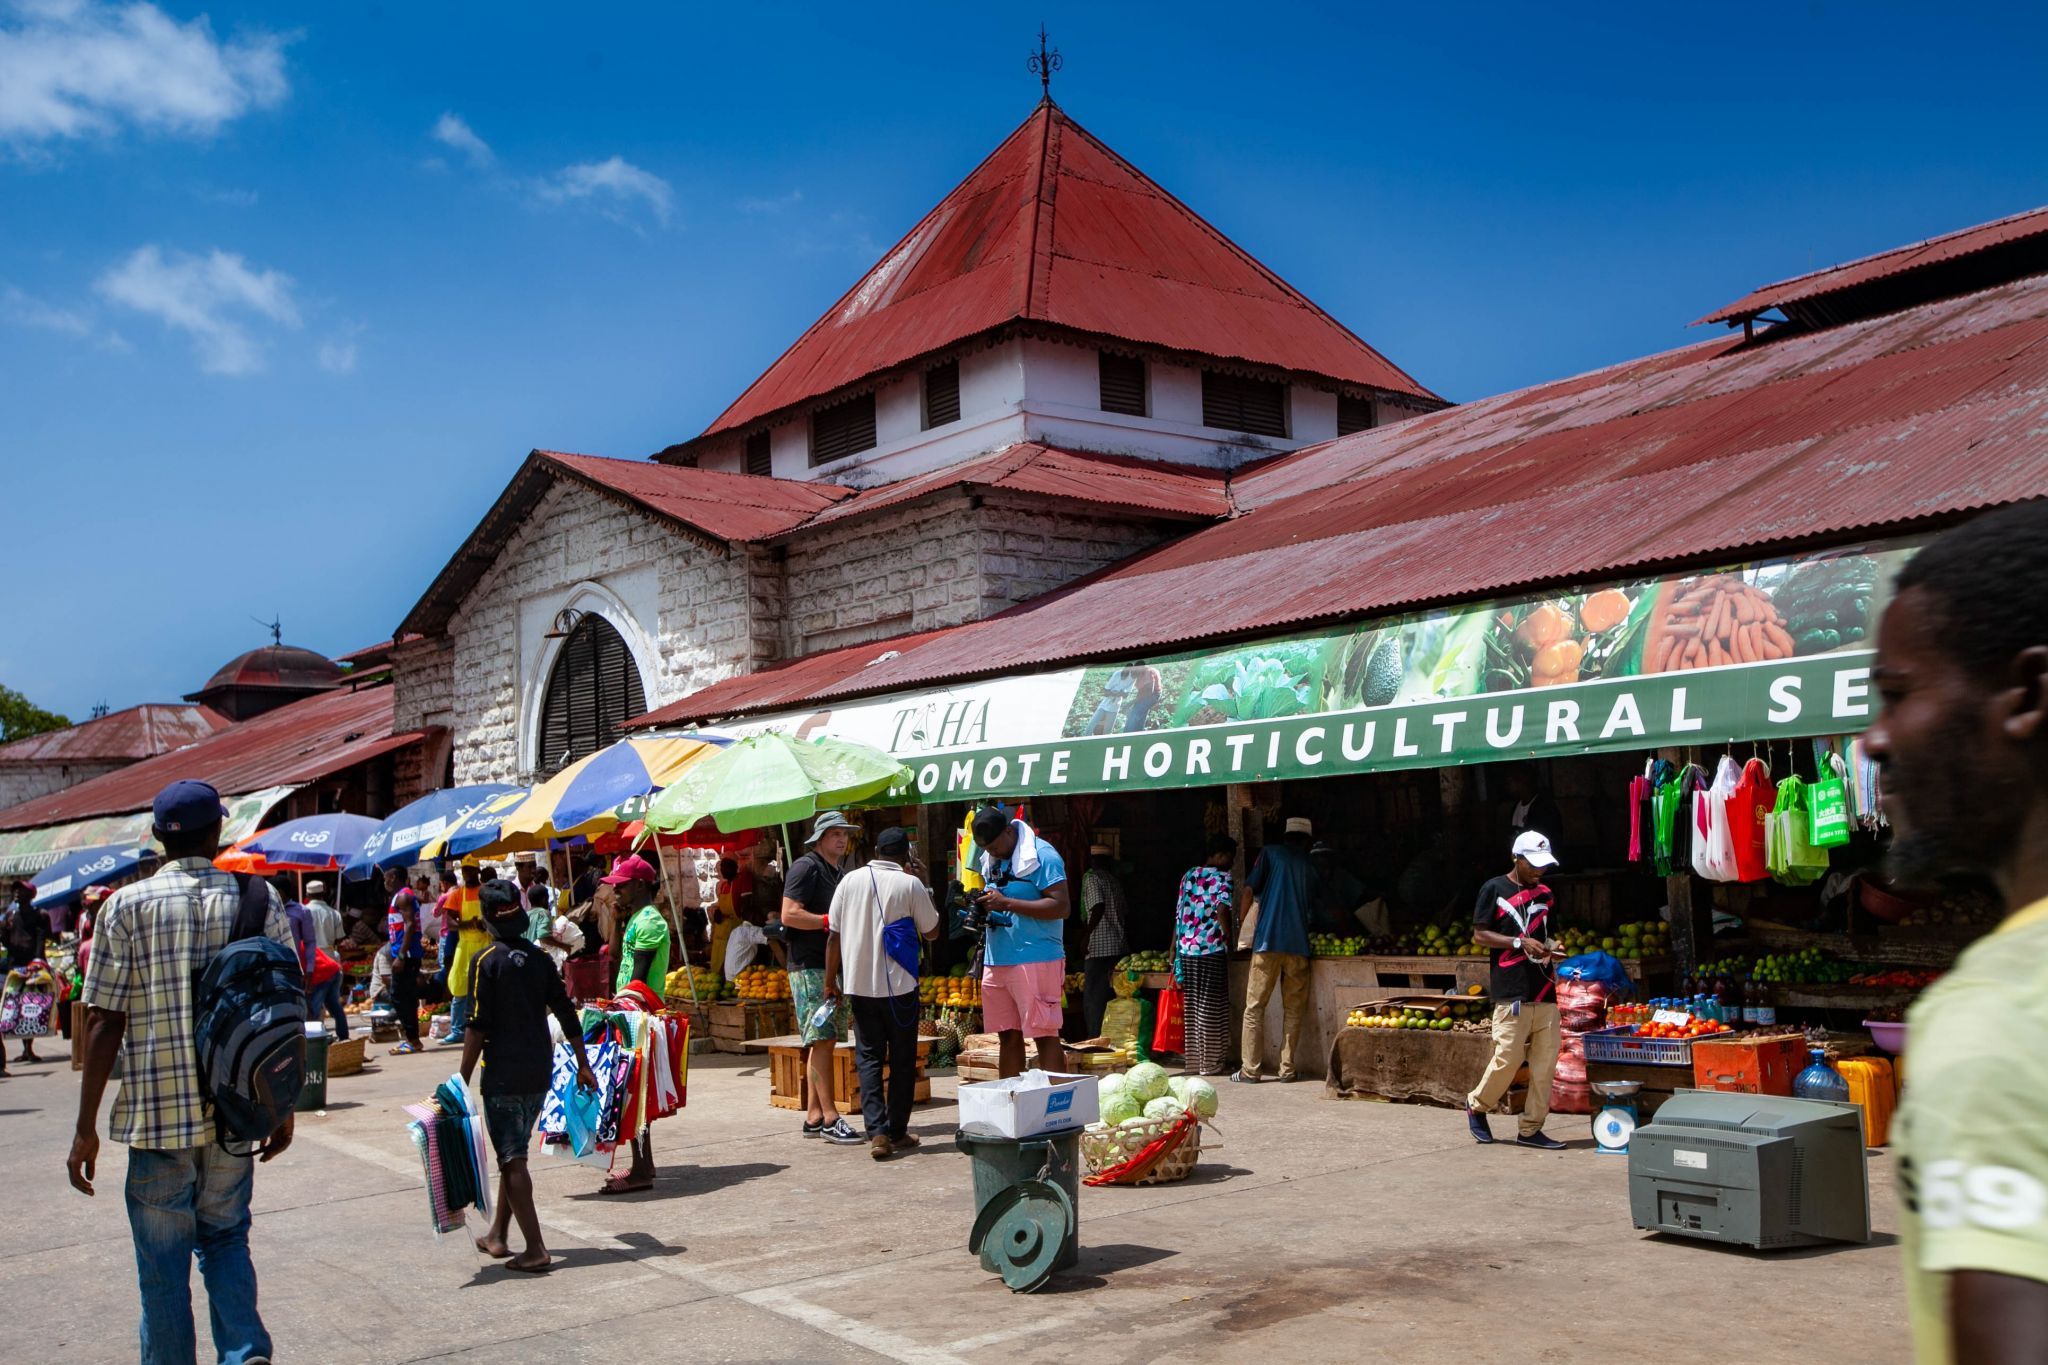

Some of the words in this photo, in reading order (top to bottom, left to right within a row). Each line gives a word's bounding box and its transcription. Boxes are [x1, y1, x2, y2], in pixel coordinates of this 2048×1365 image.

[1101, 687, 1702, 781] HORTICULTURAL
[290, 830, 331, 848] tigo
[77, 855, 117, 875] tigo
